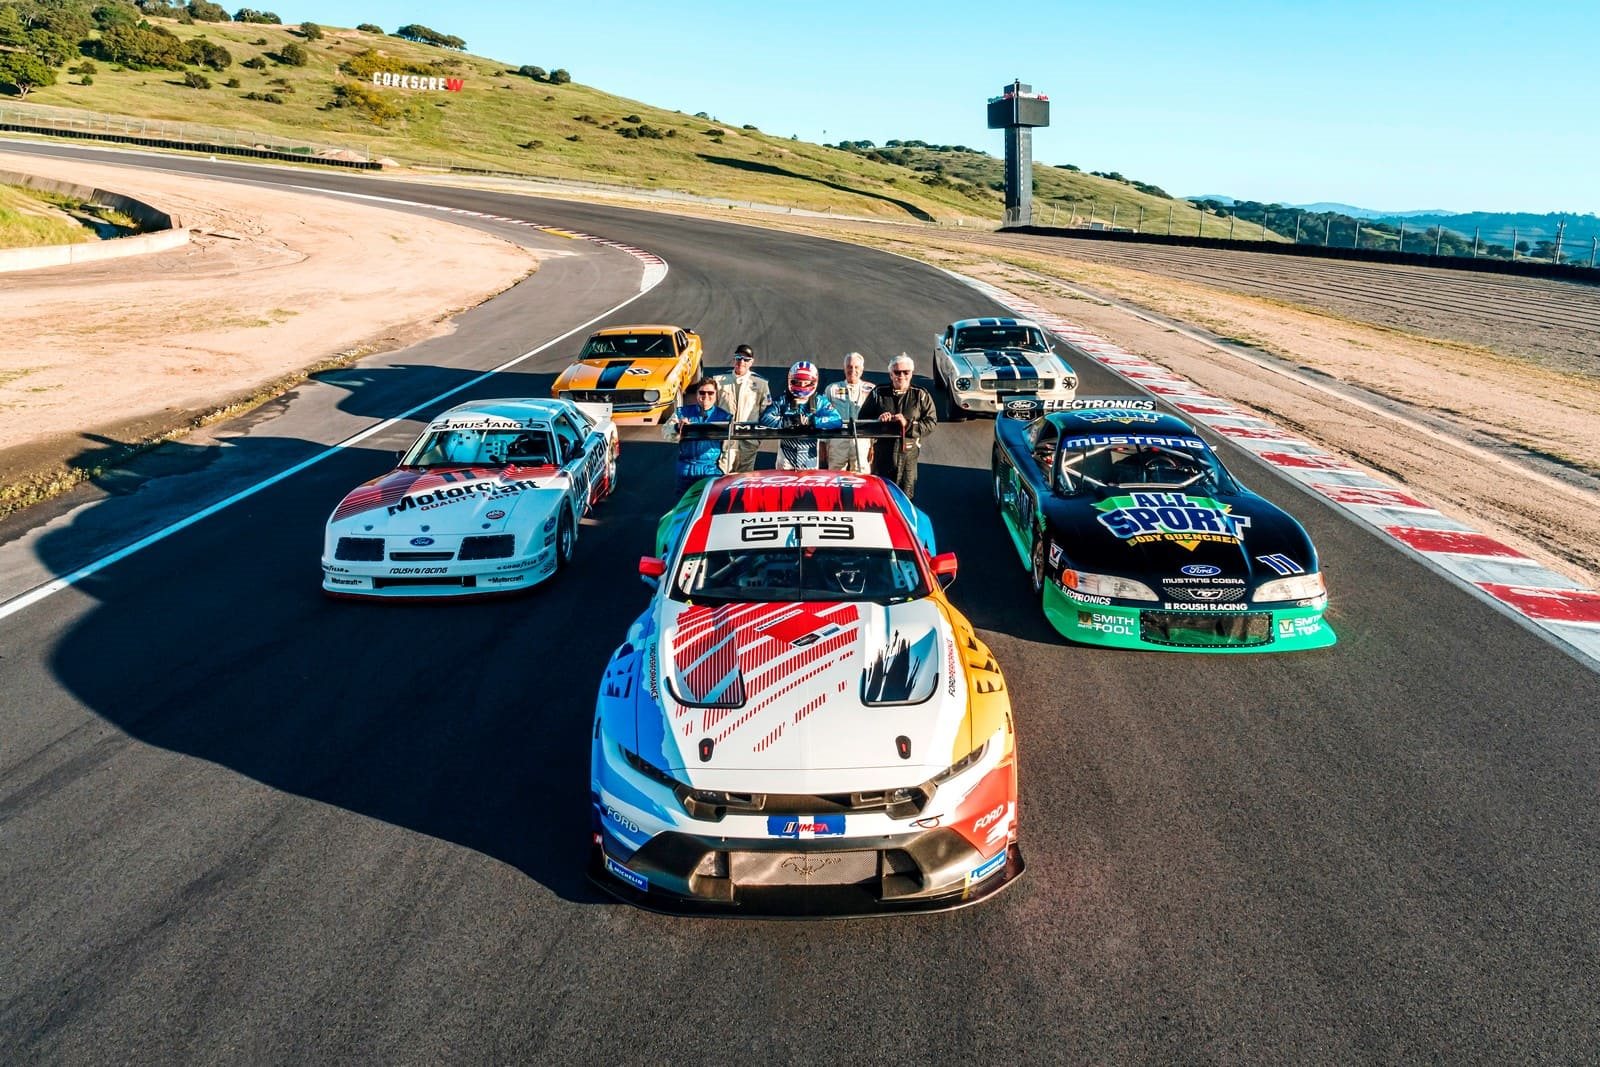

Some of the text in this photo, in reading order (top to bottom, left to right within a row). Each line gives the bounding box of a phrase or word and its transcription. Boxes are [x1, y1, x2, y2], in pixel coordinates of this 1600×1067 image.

[373, 72, 464, 92] CORKSCREW
[1043, 399, 1154, 410] ELECTRONICS
[452, 421, 523, 430] MUSTANG
[1066, 436, 1205, 449] MUSTANG
[726, 481, 866, 490] PERFORMANCE
[732, 474, 867, 485] FORD
[420, 494, 477, 511] QUALITY
[1130, 492, 1198, 508] ALL
[741, 515, 854, 524] MUSTANG
[1097, 506, 1251, 541] SPORT
[741, 523, 855, 543] GT3
[1127, 533, 1163, 547] BODY
[1187, 565, 1214, 576] Ford
[1256, 553, 1305, 576] 11
[1062, 586, 1112, 605] ELECTRONICS
[1174, 602, 1249, 611] ROUSH RACING
[1092, 613, 1135, 626] SMITH
[1093, 623, 1134, 636] TOOL
[607, 805, 640, 833] FORD
[973, 804, 1004, 833] FORD
[613, 866, 643, 885] MICHELIN
